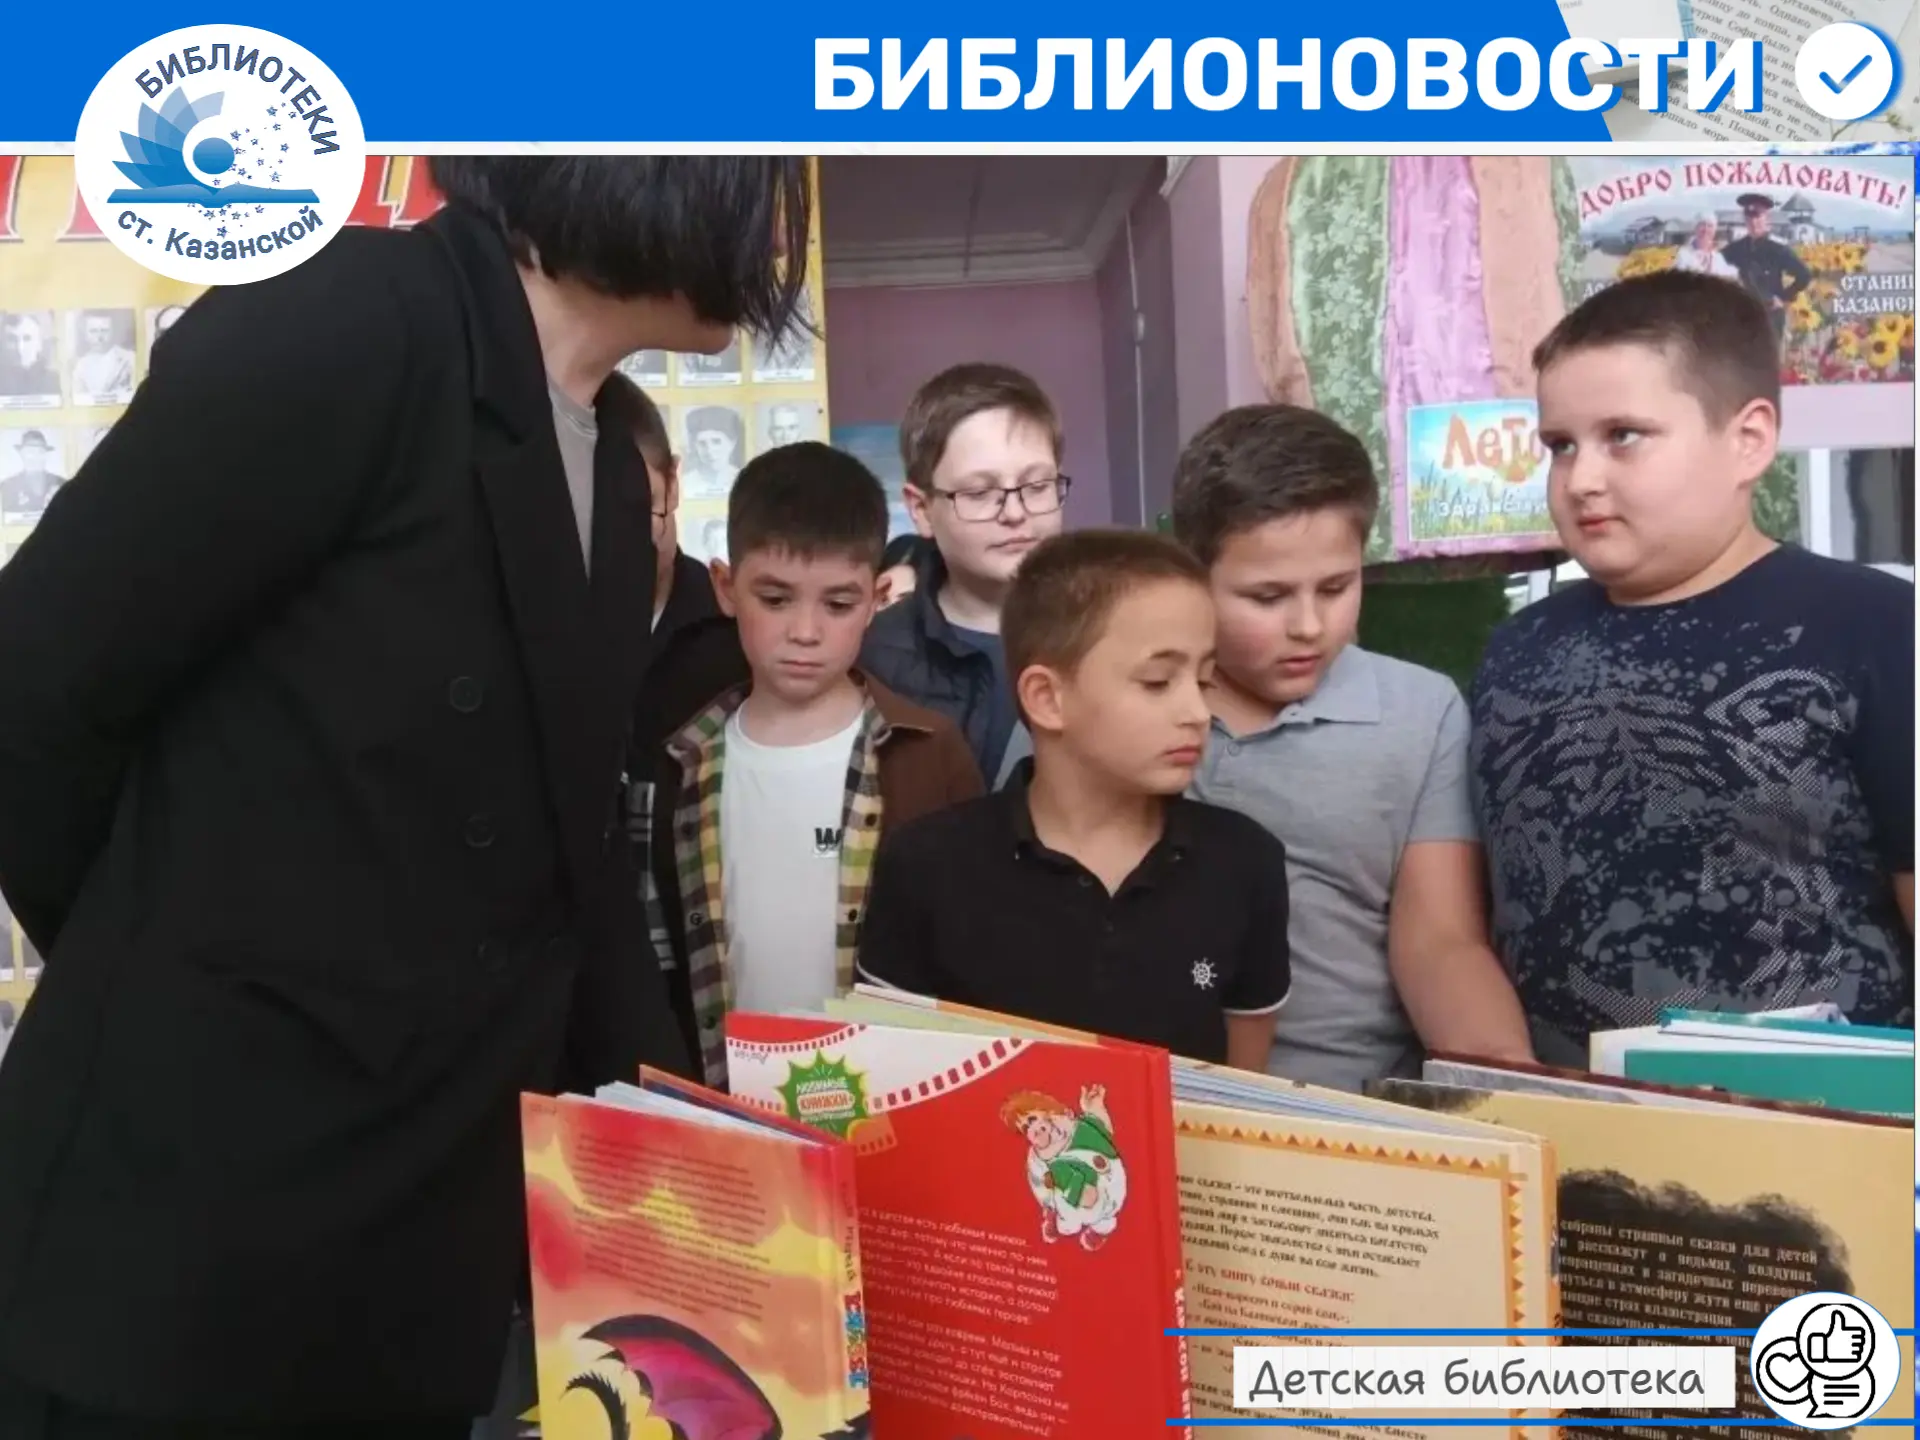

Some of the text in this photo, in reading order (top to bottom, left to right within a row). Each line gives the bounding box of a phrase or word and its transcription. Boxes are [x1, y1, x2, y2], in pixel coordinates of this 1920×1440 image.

[1581, 161, 1907, 219] ДОБРО ПОЖАЛОВАТЬ!
[1619, 1227, 1684, 1246] страшные
[1690, 1237, 1736, 1254] сказки
[1744, 1245, 1770, 1258] для
[1776, 1248, 1817, 1265] детей
[1198, 1265, 1216, 1280] эту
[1220, 1269, 1257, 1287] книгу
[1578, 1240, 1647, 1259] расскажут
[1659, 1252, 1666, 1262] о
[1678, 1255, 1735, 1273] ведьмах,
[1748, 1264, 1817, 1284] колдунах,
[1657, 1270, 1733, 1290] загадочных
[1620, 1282, 1688, 1304] атмосферу
[1693, 1293, 1730, 1309] жути
[1605, 1296, 1735, 1327] страх иллюстрации.
[992, 1335, 1030, 1355] Малыш
